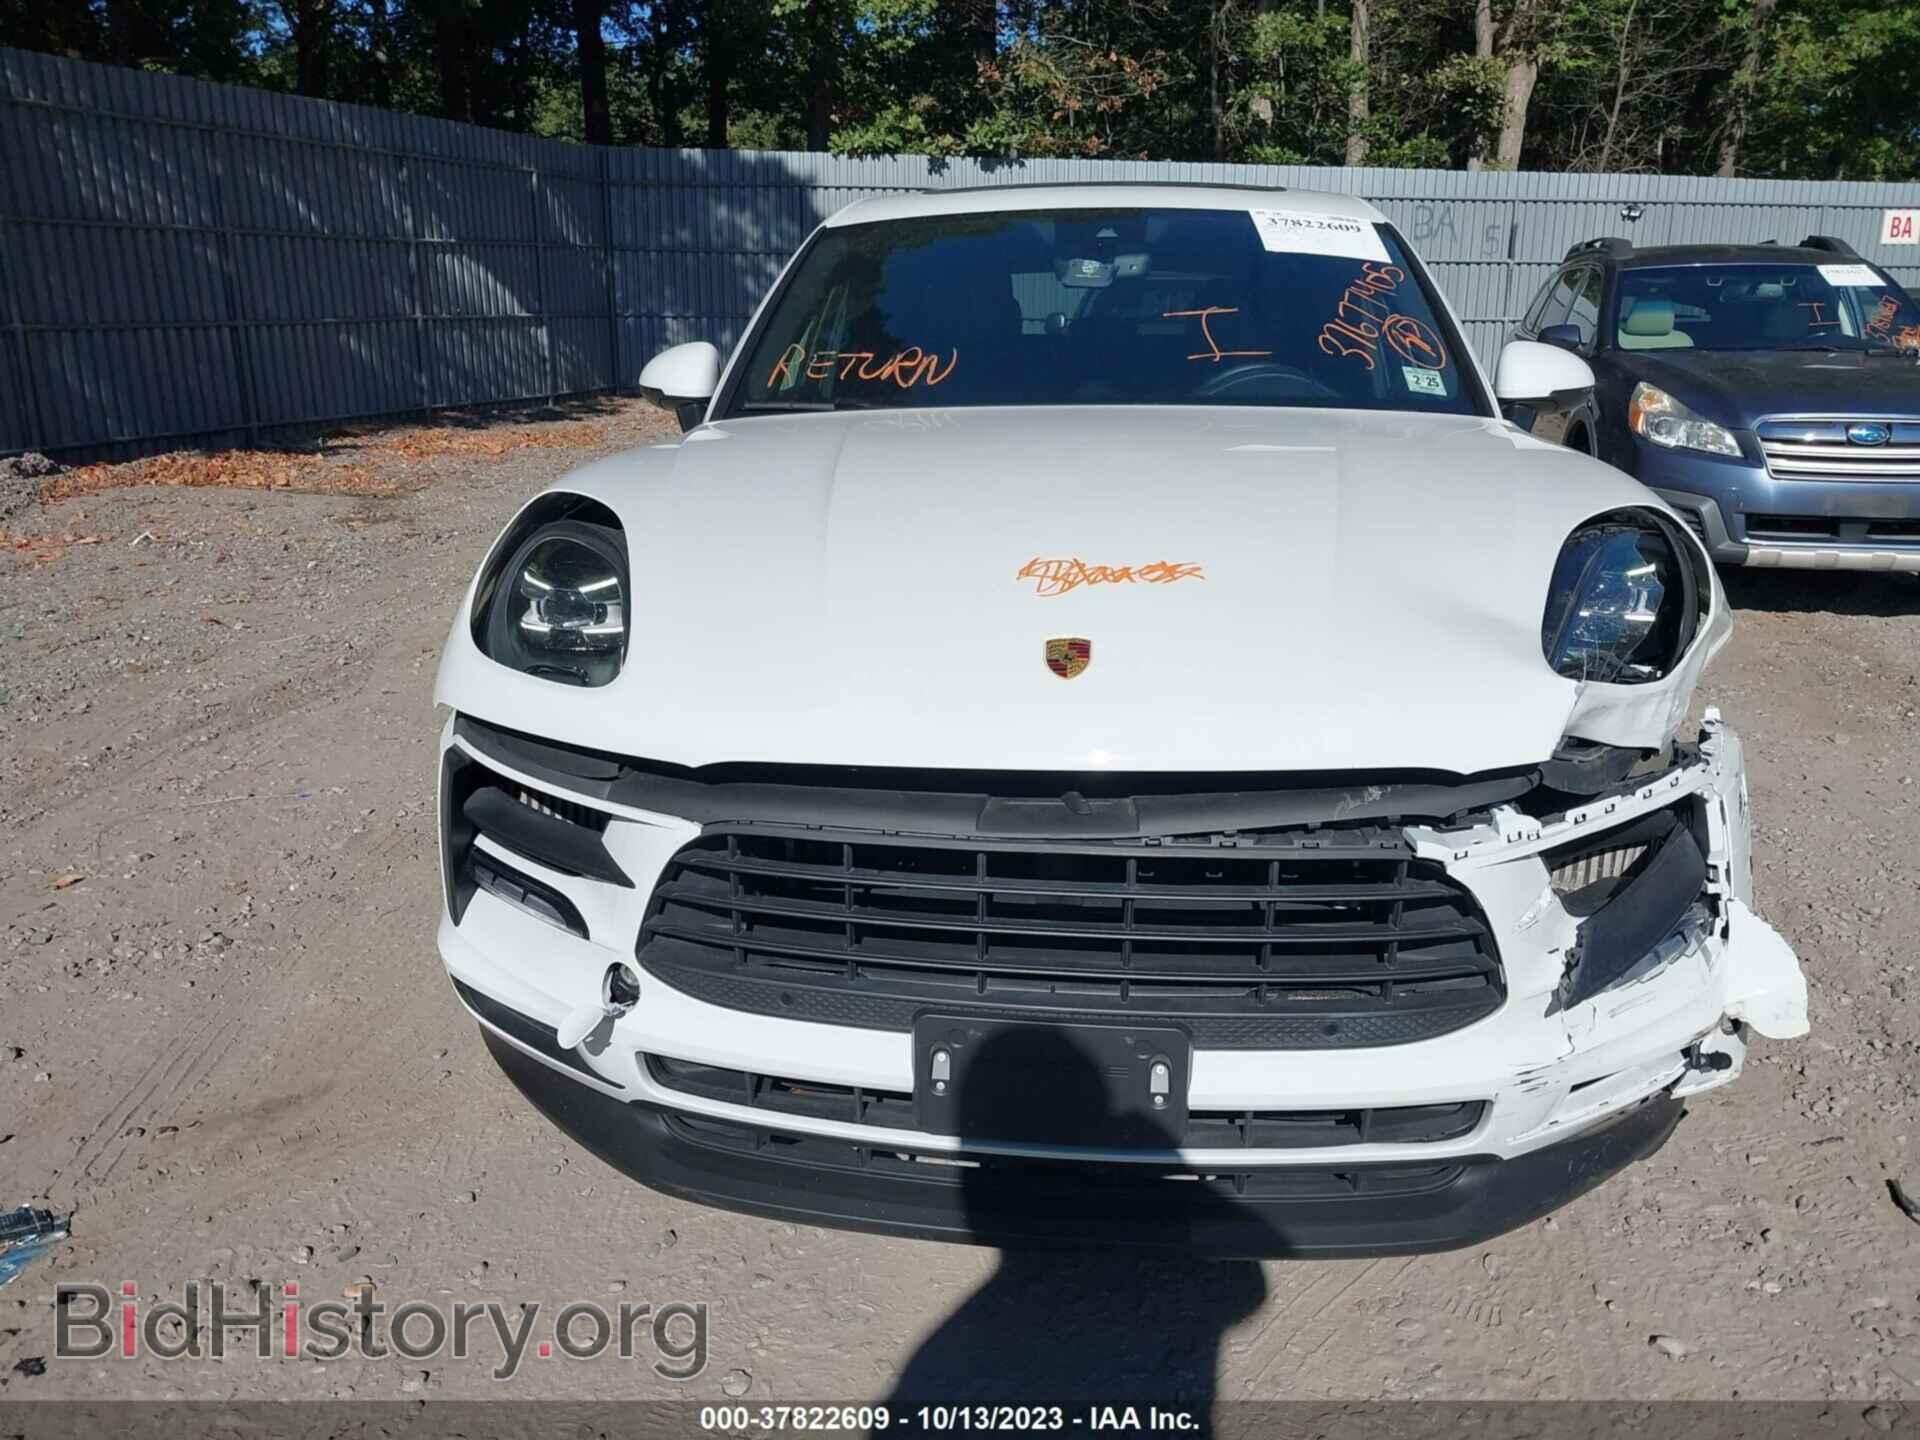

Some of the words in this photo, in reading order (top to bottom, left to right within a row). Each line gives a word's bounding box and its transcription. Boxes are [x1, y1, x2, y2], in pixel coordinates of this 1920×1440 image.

[1414, 204, 1457, 242] BA
[1890, 216, 1912, 238] BA
[767, 344, 957, 391] RETURN
[1413, 375, 1421, 385] 2
[1426, 376, 1440, 388] 25
